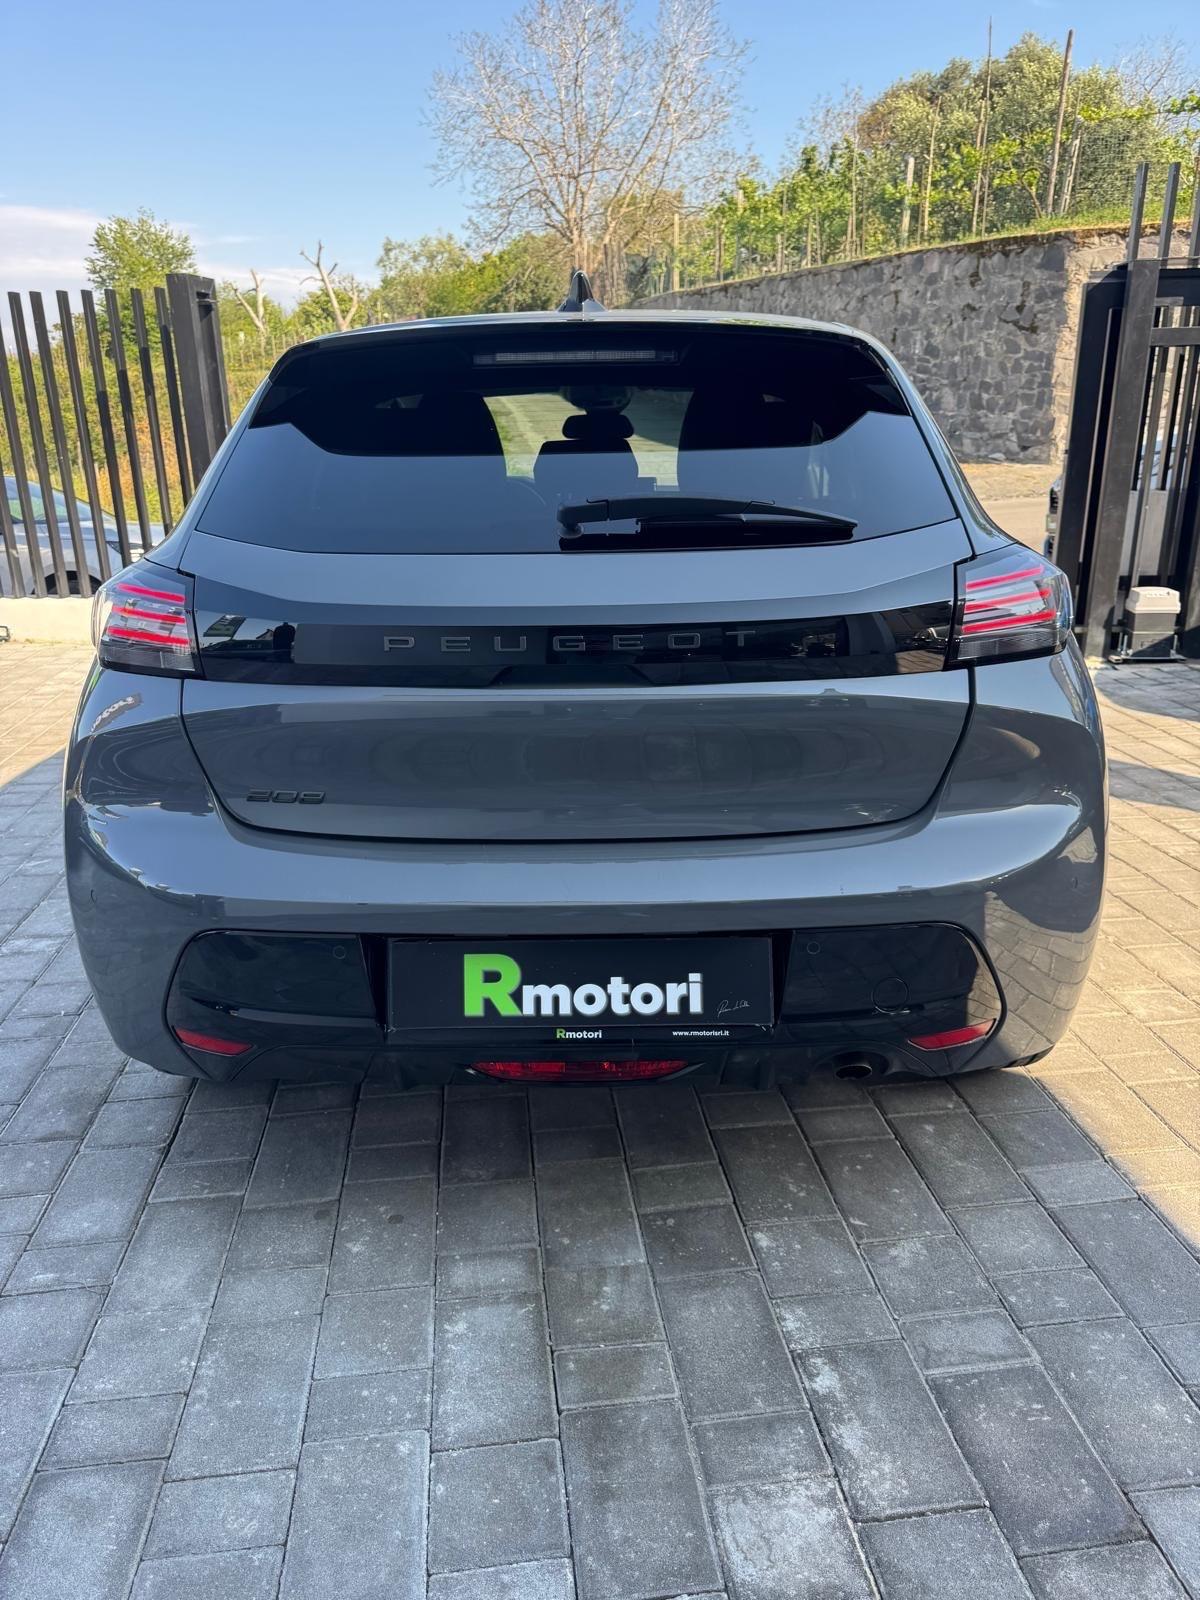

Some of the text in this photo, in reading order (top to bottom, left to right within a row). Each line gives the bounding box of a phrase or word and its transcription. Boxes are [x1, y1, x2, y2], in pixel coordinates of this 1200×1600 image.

[383, 630, 756, 652] PEUGEOT
[246, 788, 326, 804] 208
[463, 953, 704, 1017] Rmotori
[556, 1028, 603, 1039] Rmotori
